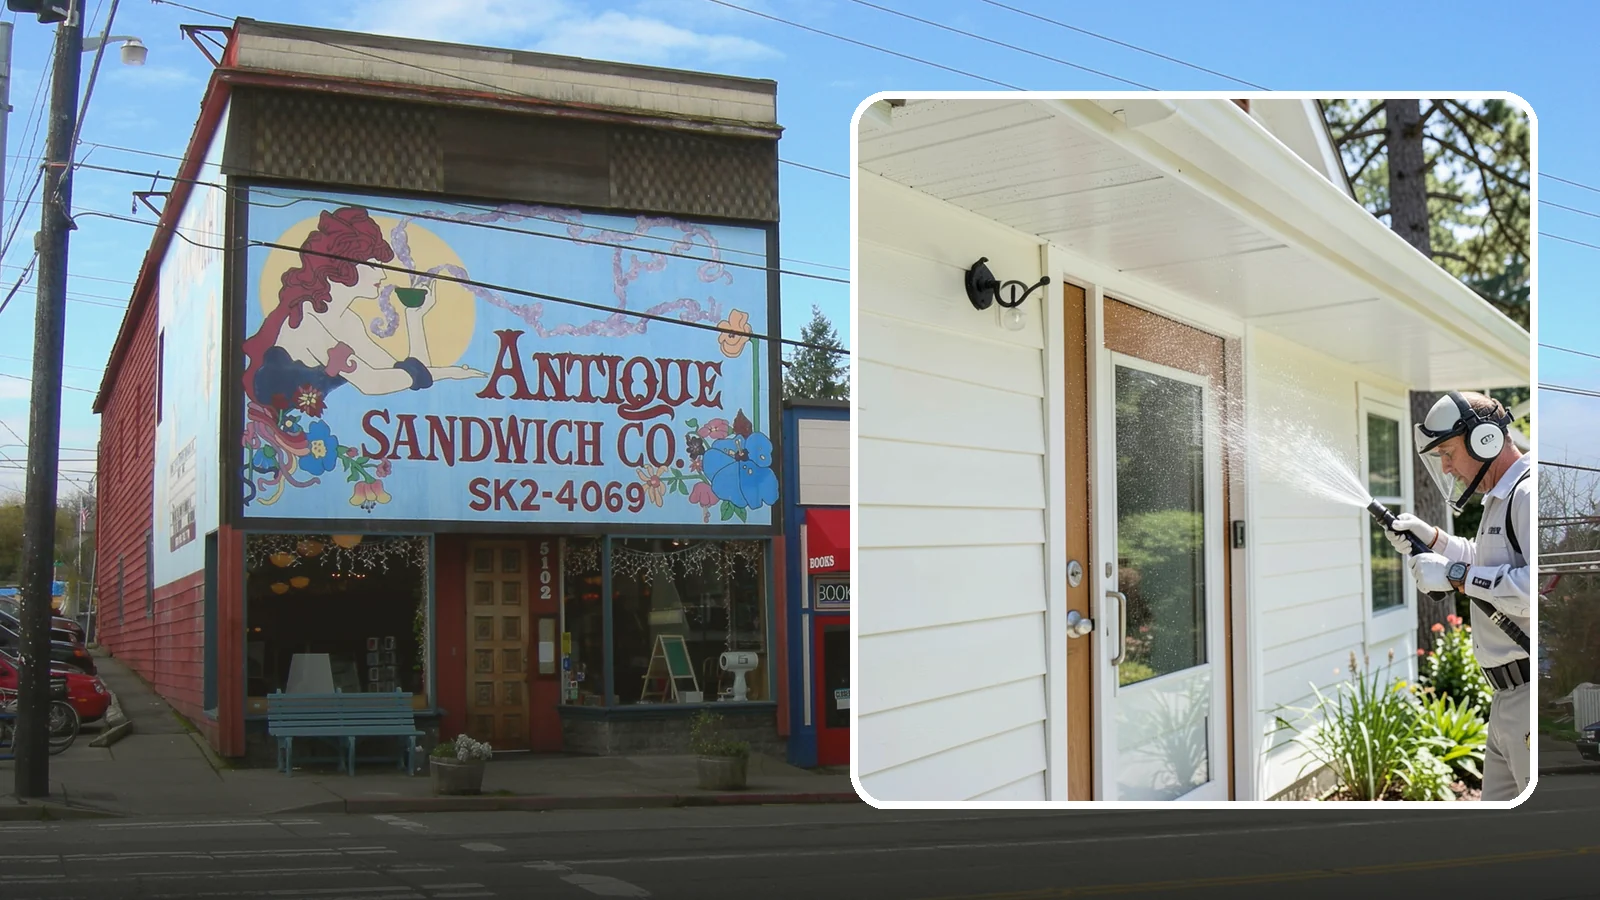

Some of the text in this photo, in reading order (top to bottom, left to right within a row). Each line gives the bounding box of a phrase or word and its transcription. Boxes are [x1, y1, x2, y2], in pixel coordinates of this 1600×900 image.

[476, 329, 724, 421] ANTIQUE
[361, 408, 686, 470] SANDWICH CO.
[468, 476, 646, 512] SK2-4069
[539, 541, 552, 600] 5102
[809, 554, 835, 569] BOOKS
